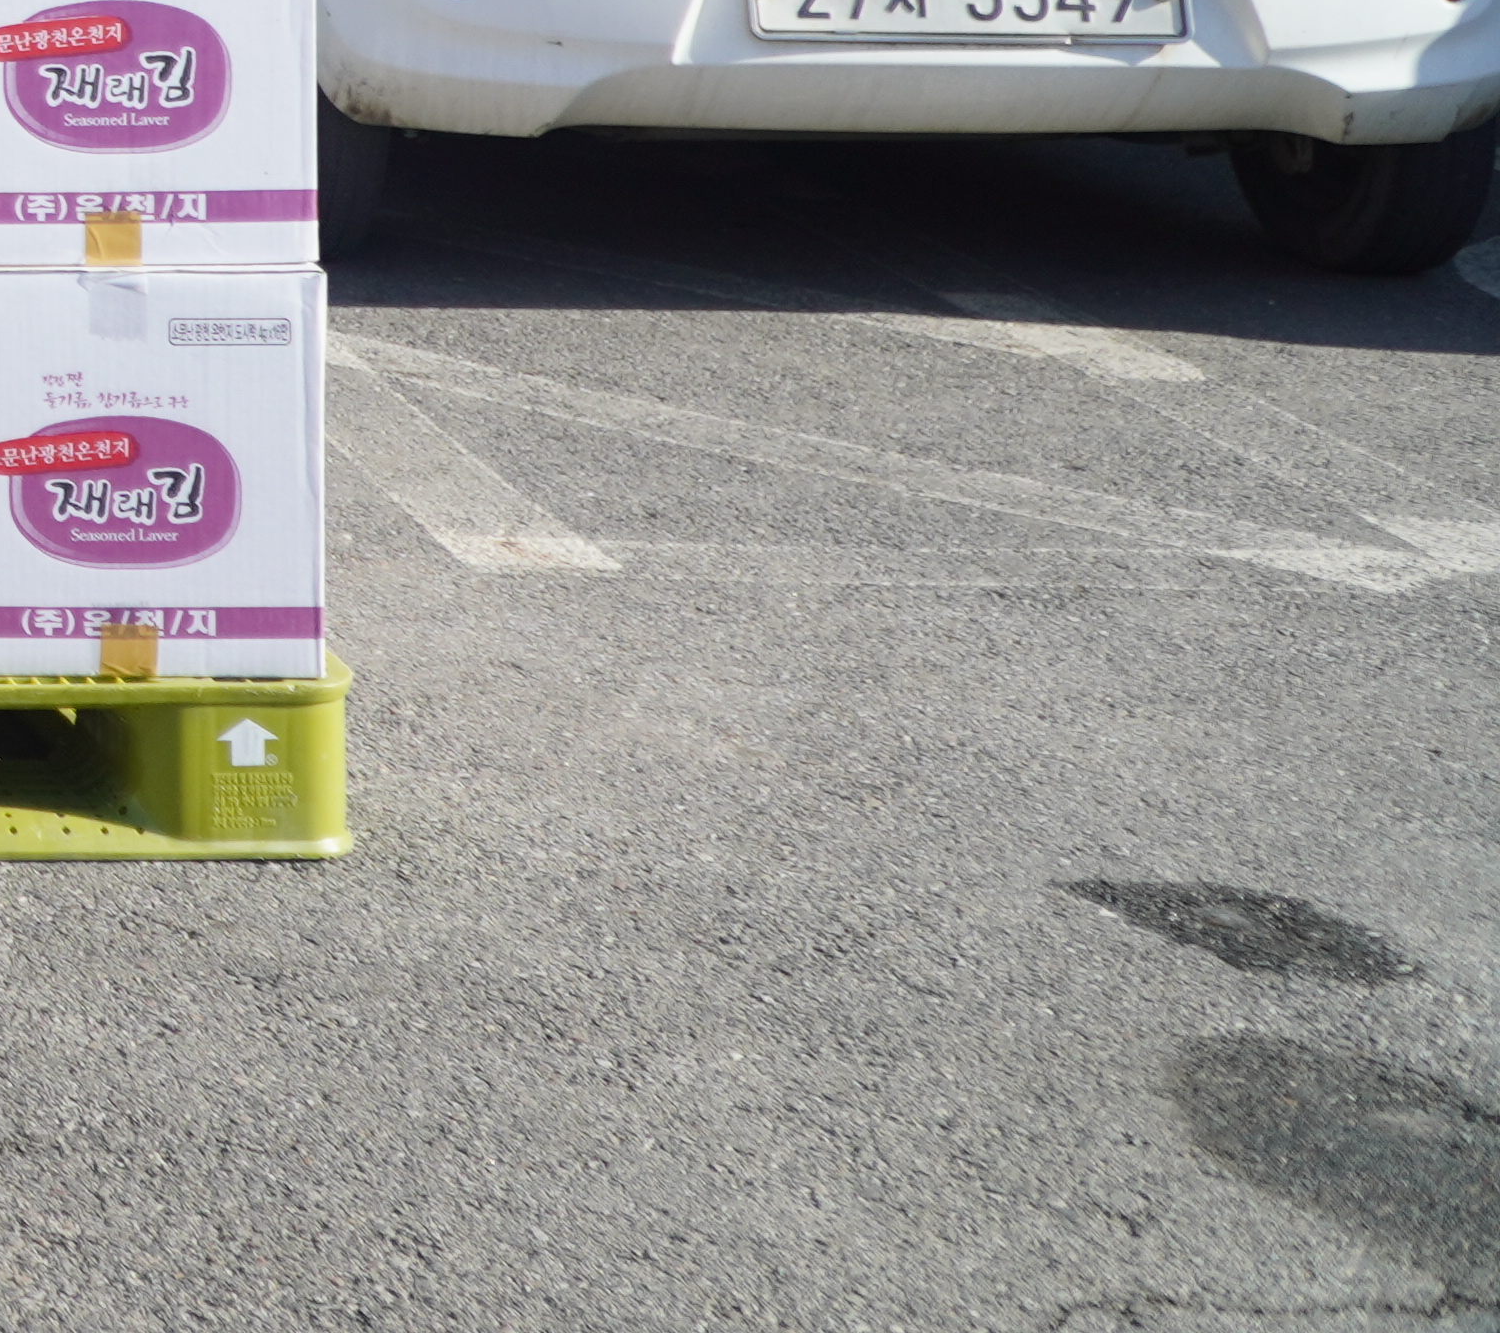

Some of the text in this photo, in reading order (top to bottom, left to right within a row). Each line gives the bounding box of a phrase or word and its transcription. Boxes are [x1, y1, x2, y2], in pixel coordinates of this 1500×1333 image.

[40, 47, 196, 108] 재래김
[64, 113, 170, 127] Seasoned Laver
[46, 462, 205, 524] 재래김
